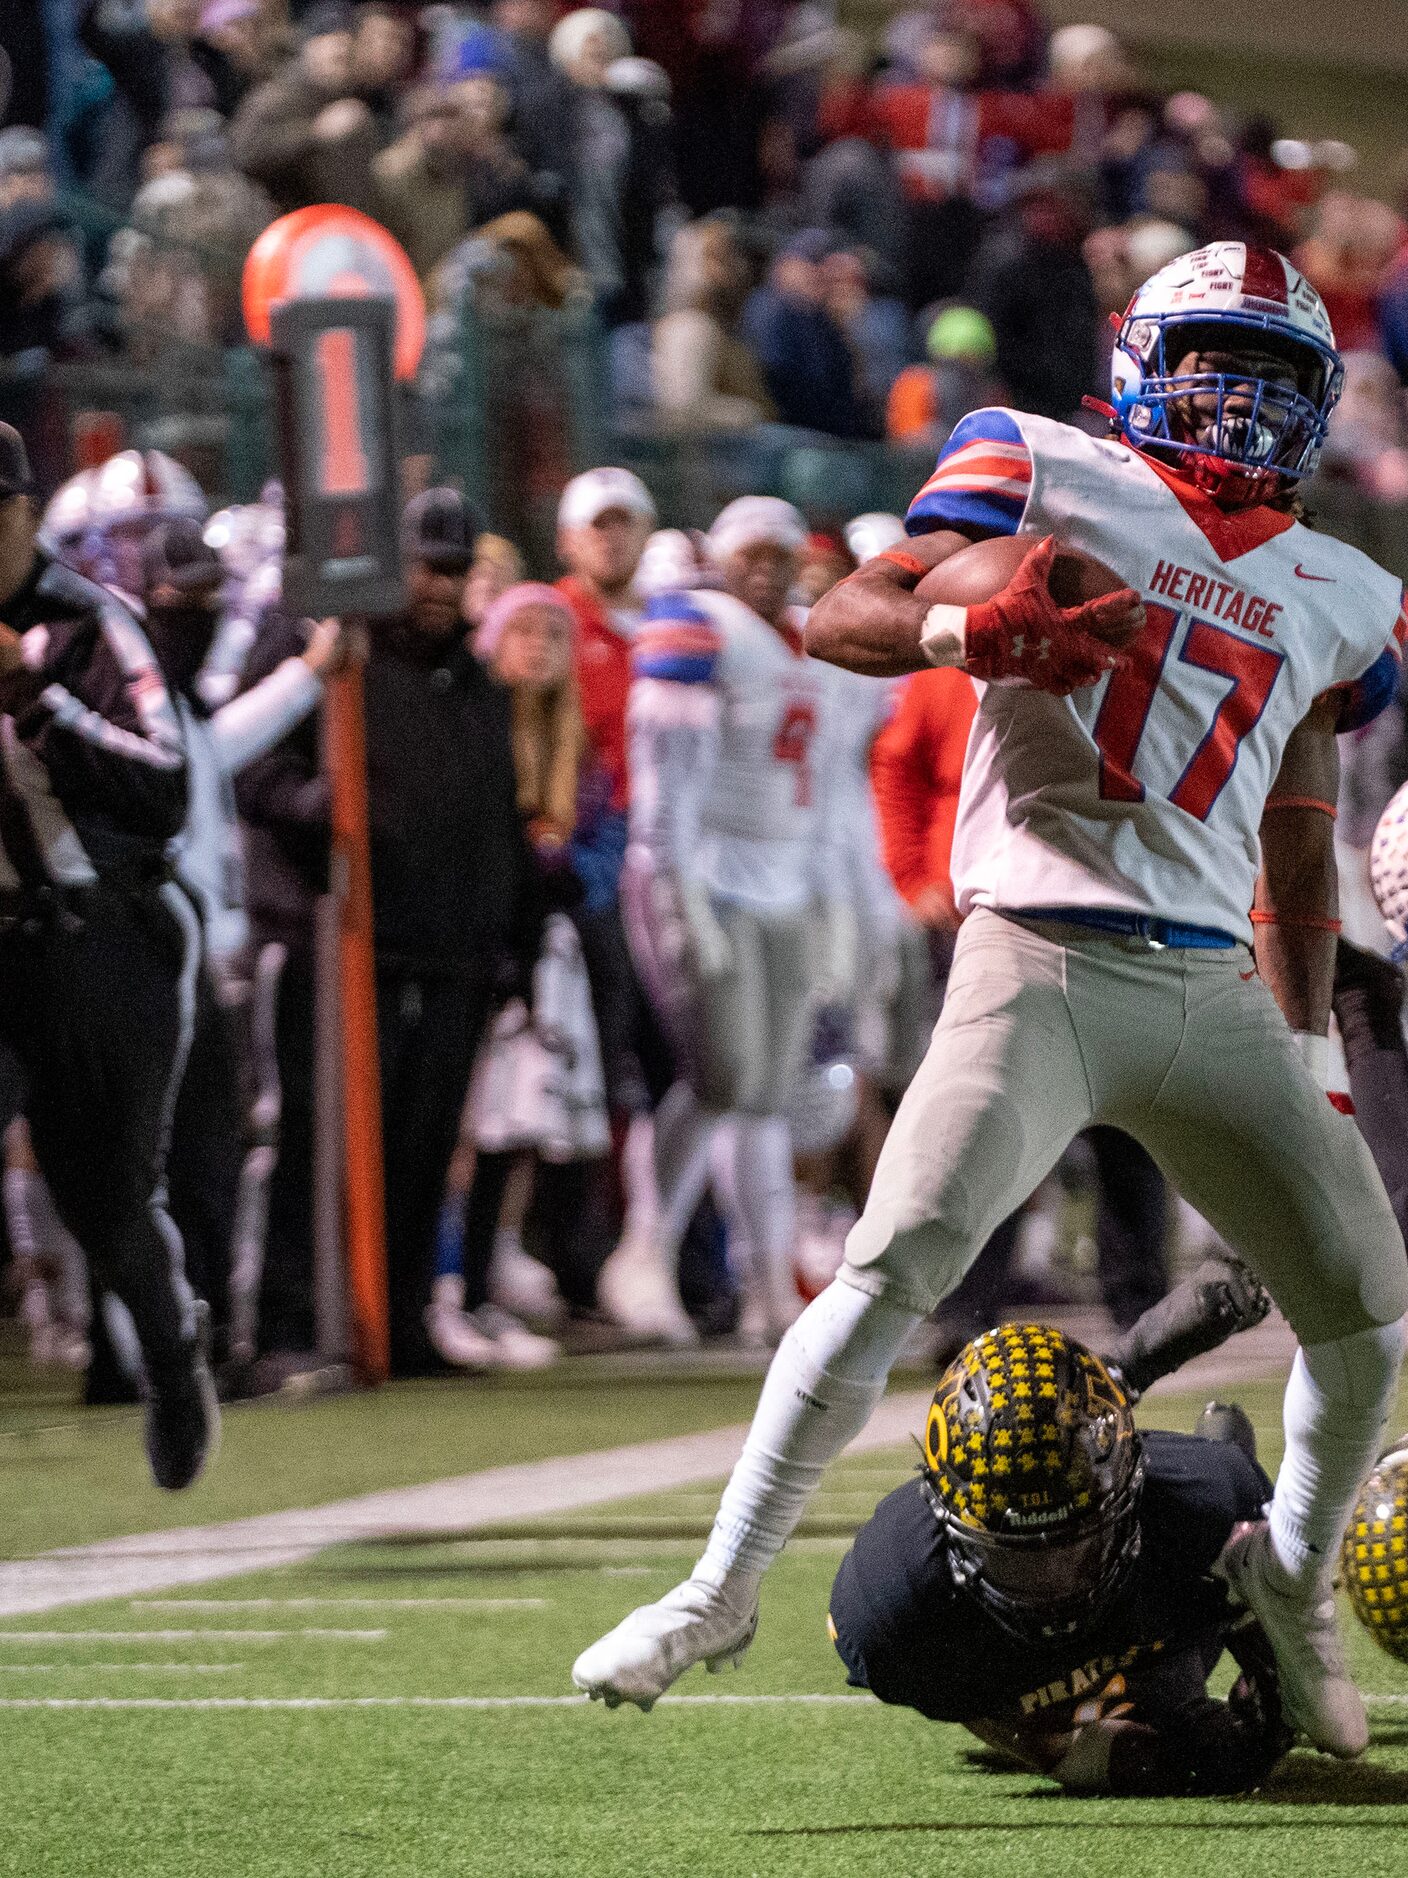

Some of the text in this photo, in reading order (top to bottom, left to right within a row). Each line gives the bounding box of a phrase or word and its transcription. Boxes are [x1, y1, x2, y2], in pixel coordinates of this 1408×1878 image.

[1209, 281, 1234, 291] FIGHT
[316, 328, 369, 496] 1
[1149, 559, 1284, 638] HERITAGE
[1092, 599, 1286, 822] 17
[1008, 1504, 1069, 1527] Riddell
